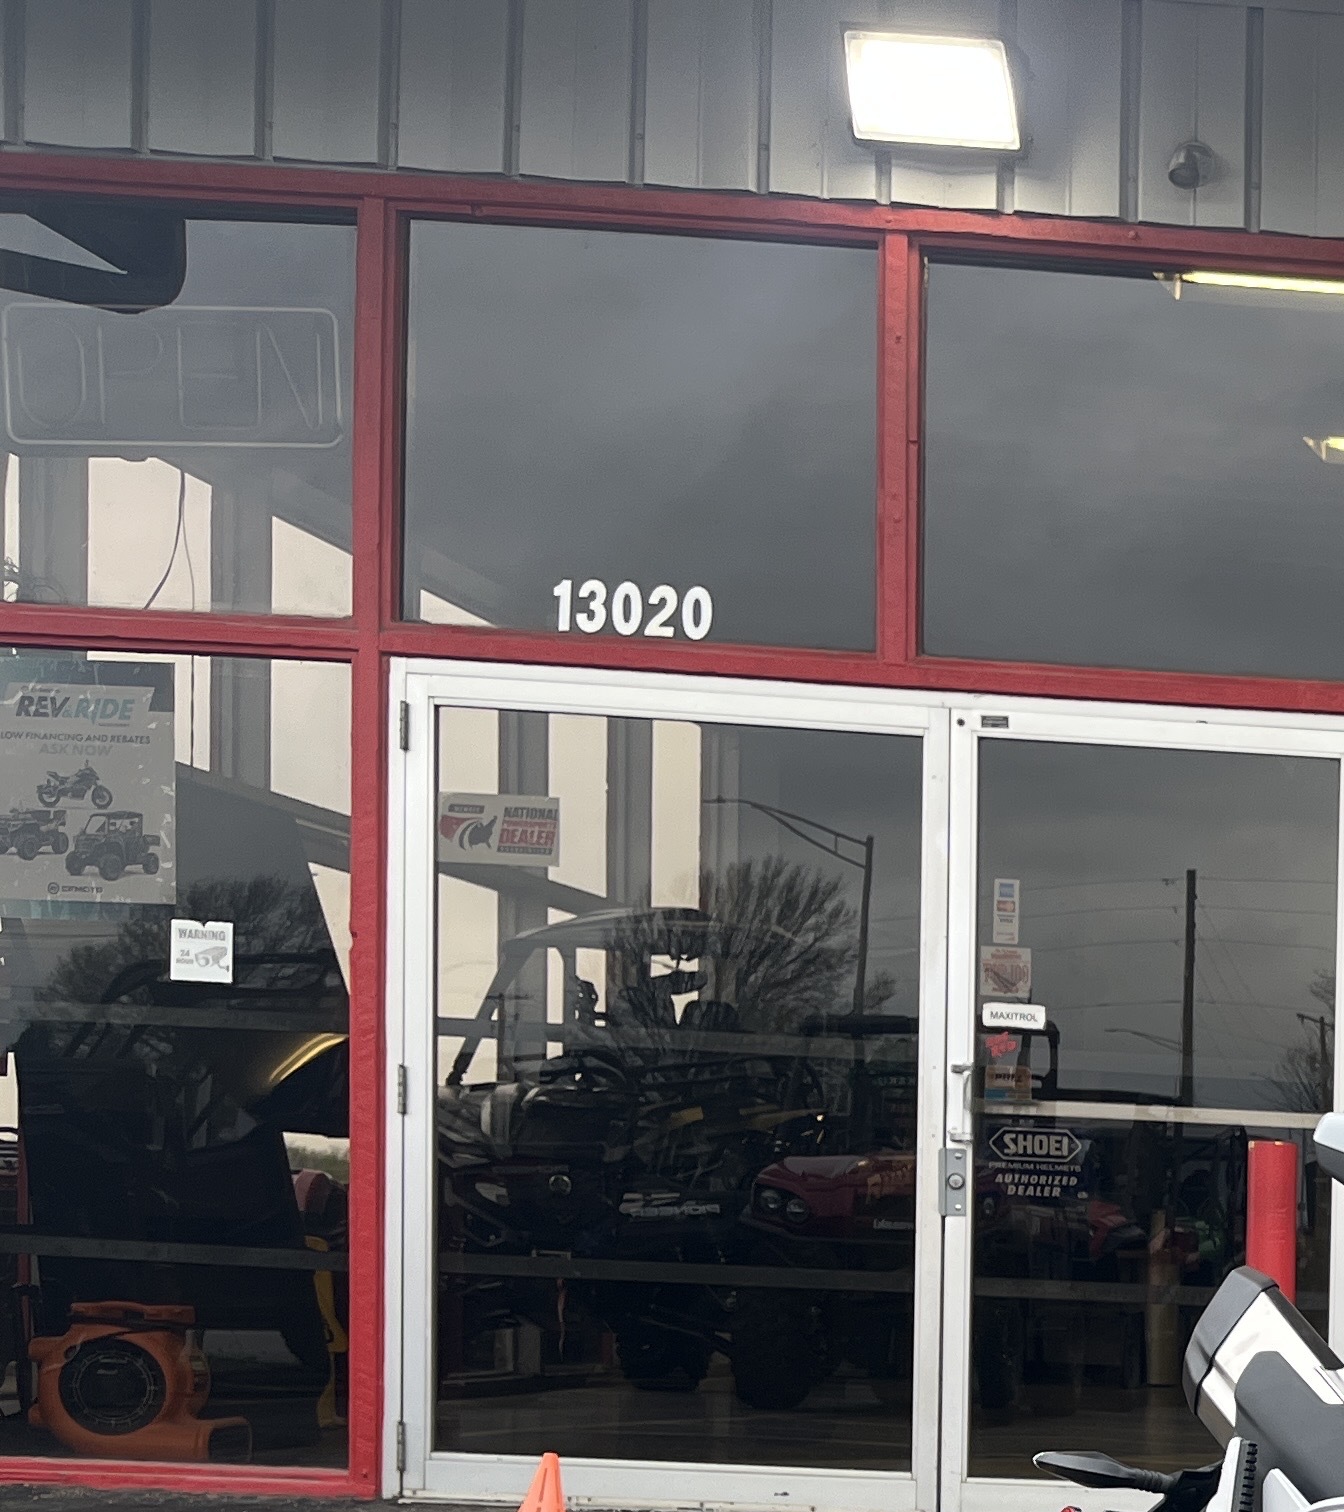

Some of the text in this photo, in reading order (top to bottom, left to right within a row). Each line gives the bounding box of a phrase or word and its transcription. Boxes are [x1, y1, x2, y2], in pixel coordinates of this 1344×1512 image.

[553, 579, 713, 640] 13020
[499, 828, 556, 847] DEALER
[178, 927, 226, 942] WARNING
[990, 1010, 1038, 1023] MAXITROL
[1002, 1132, 1069, 1156] SHOEI
[994, 1172, 1078, 1186] AUTHORIZED
[1006, 1185, 1062, 1198] DEALER
